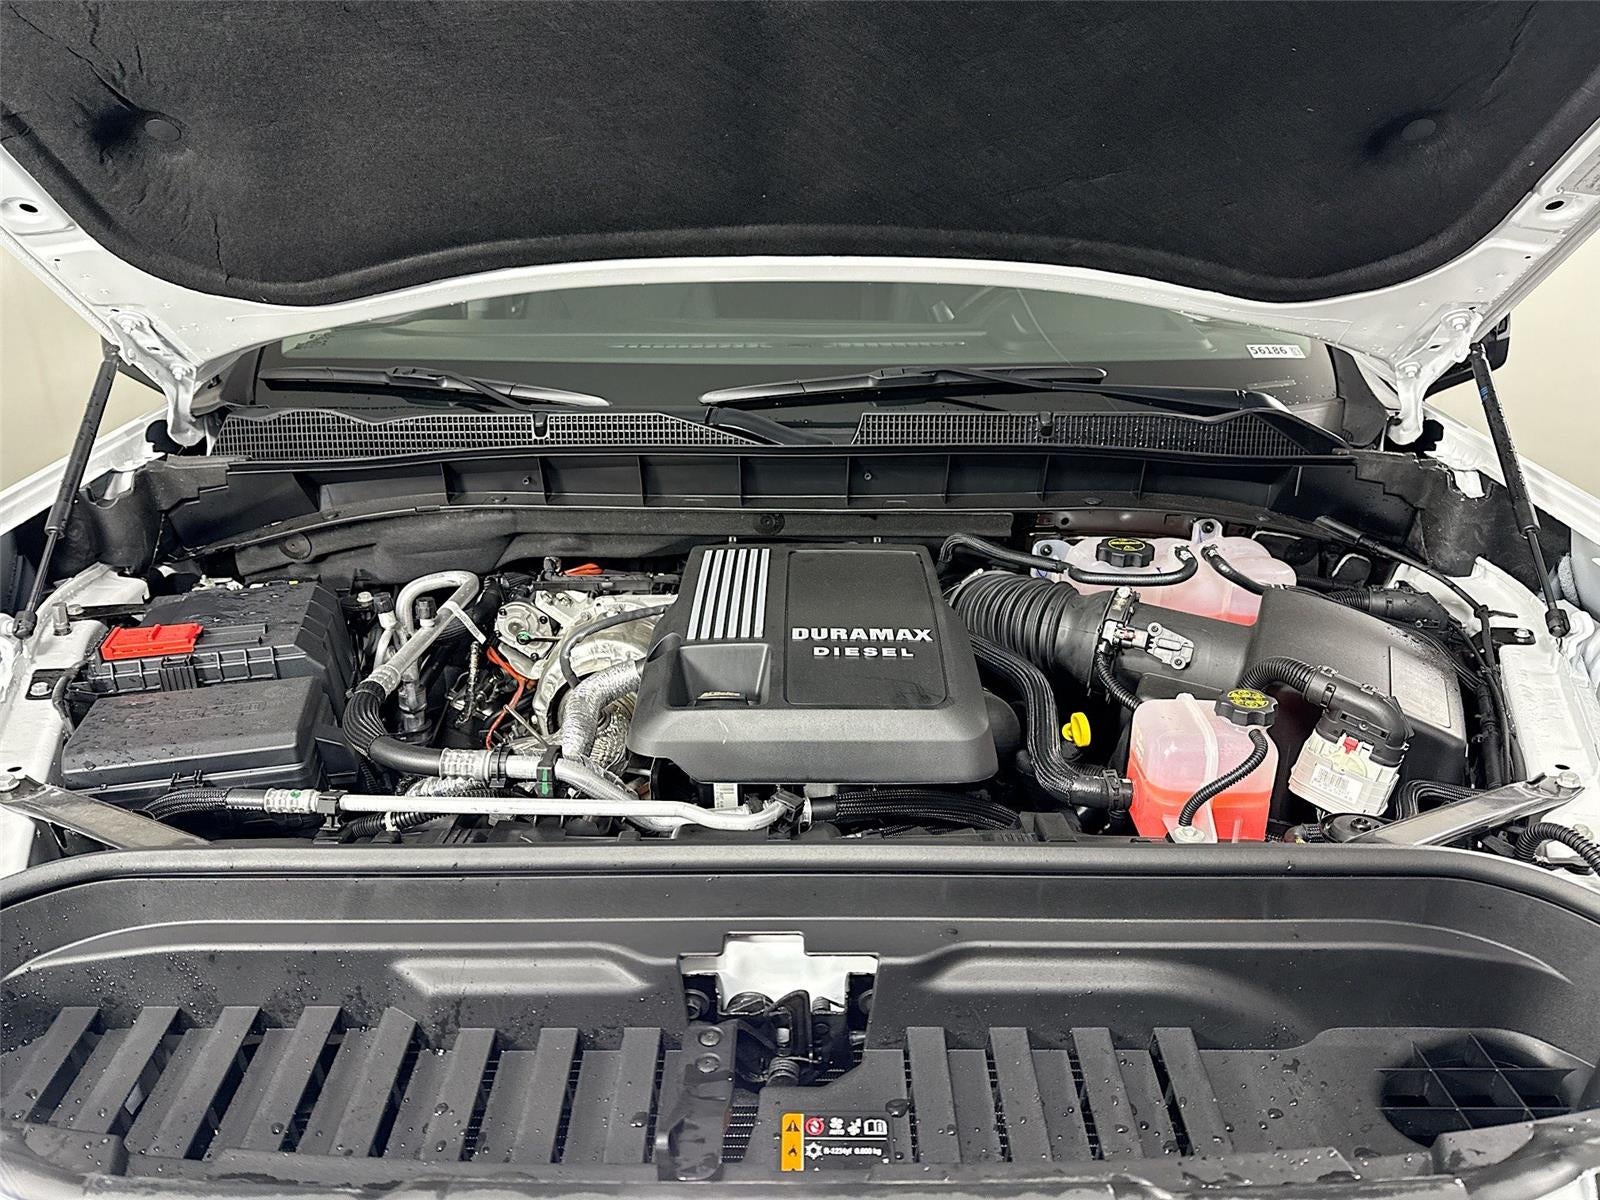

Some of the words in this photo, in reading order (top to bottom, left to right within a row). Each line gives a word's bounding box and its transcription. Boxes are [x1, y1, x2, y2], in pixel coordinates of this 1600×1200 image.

[1250, 346, 1288, 355] 56186
[791, 627, 933, 642] DURAMAX
[813, 646, 915, 658] DIESEL
